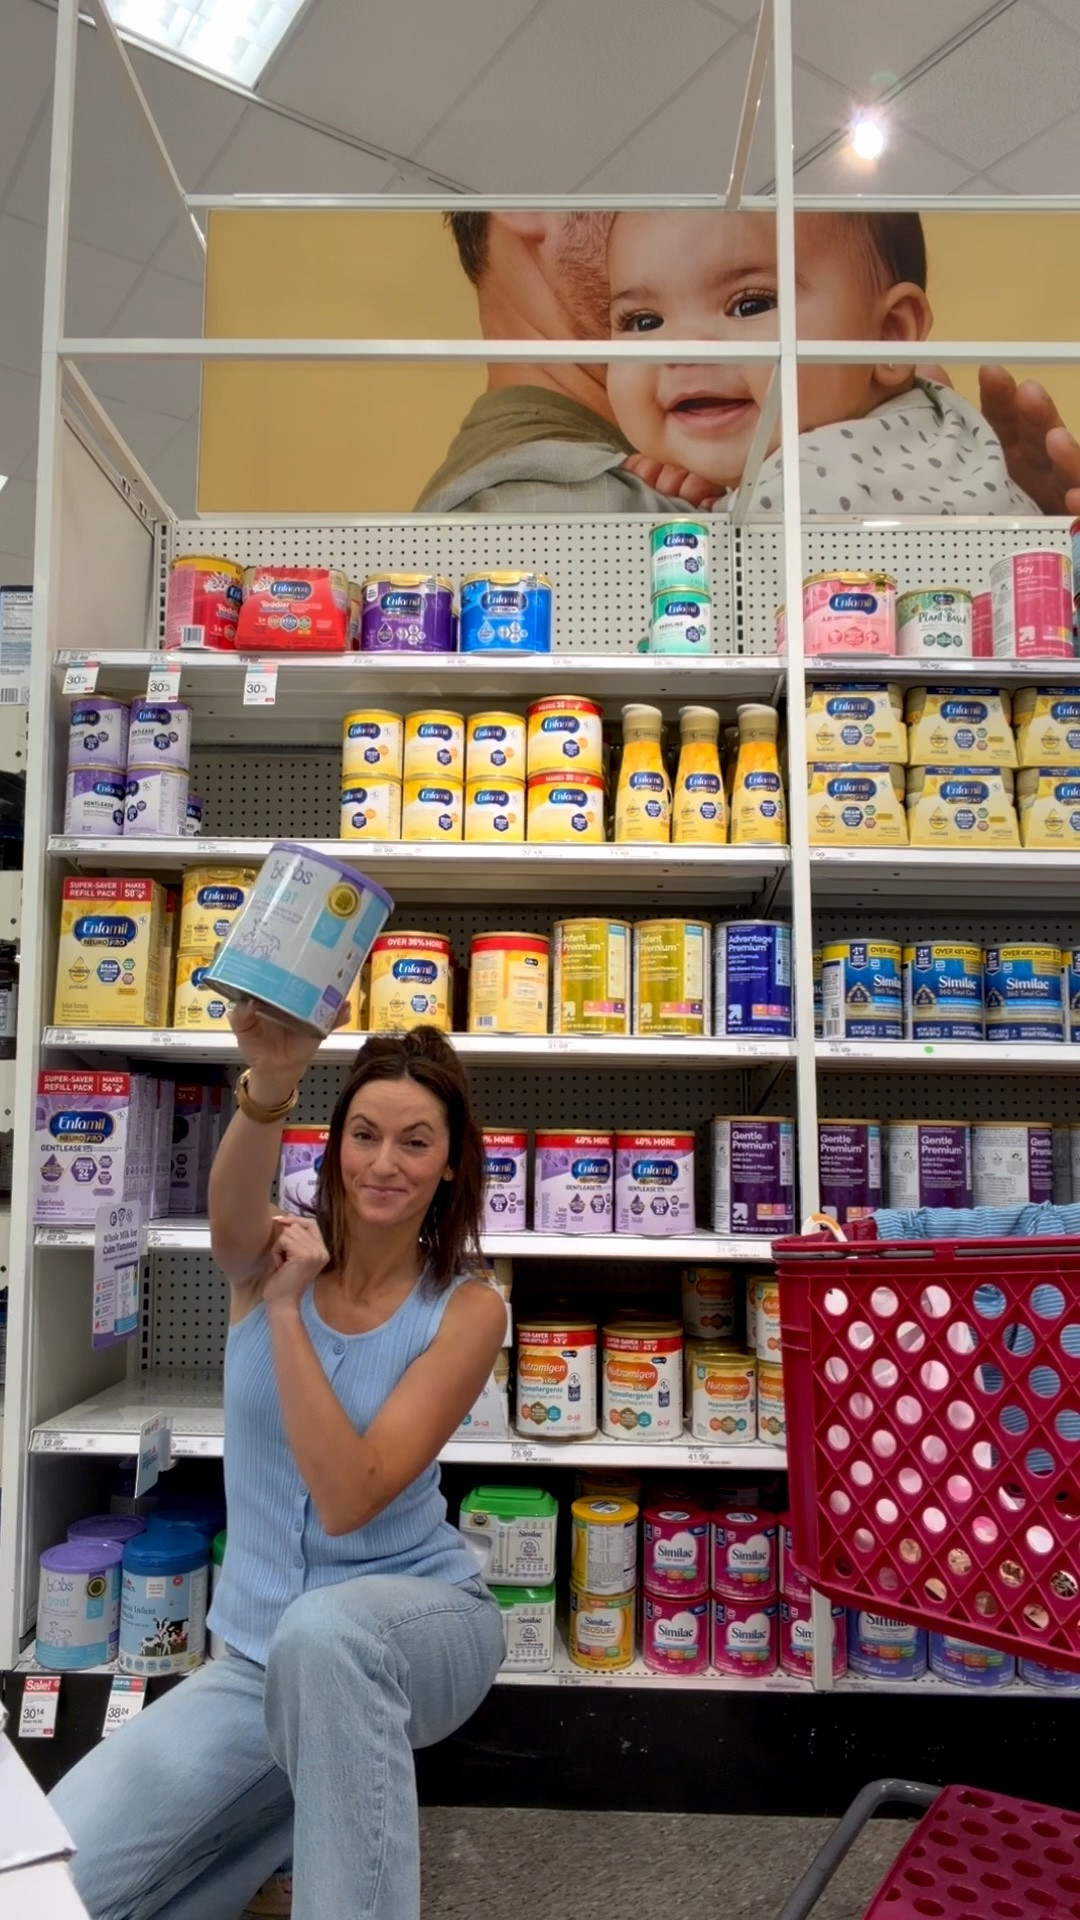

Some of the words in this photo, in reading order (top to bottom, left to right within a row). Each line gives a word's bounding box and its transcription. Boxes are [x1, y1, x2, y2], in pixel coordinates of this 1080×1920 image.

[665, 534, 697, 547] Enfamil
[1017, 565, 1034, 575] Soy
[834, 595, 874, 608] Enfamil
[667, 603, 698, 615] Enfamil
[832, 700, 868, 711] Enfamil
[946, 704, 981, 715] Enfamil
[1056, 705, 1080, 715] Enfa
[543, 718, 575, 729] Enfamil
[350, 726, 377, 736] Enfamil
[420, 725, 449, 736] Enfamil
[475, 728, 504, 738] Enfamil
[633, 776, 661, 784] Enfamil
[689, 778, 717, 786] Enfamil
[748, 776, 777, 784] Enfamil
[833, 780, 870, 793] Enfamil
[946, 783, 983, 795] Enfamil
[421, 791, 450, 801] Enfamil
[477, 793, 506, 803] Enfamil
[552, 791, 585, 802] Enfamil
[70, 889, 95, 897] REFILL
[97, 889, 116, 897] PACK
[202, 890, 239, 902] Enfamil
[82, 922, 129, 934] Enfamil
[387, 938, 407, 946] OVER
[424, 940, 443, 949] MORE
[728, 935, 773, 945] Advantage
[728, 944, 767, 952] Premium
[1002, 950, 1021, 958] OVER
[398, 963, 433, 974] Enfamil
[938, 976, 977, 989] Similac
[1006, 977, 1049, 990] Similac
[44, 1075, 94, 1083] SUPER-SAVER
[44, 1084, 71, 1092] REFILL
[73, 1084, 93, 1092] PACK
[102, 1084, 112, 1092] 56
[58, 1116, 106, 1130] Enfamil
[493, 1136, 514, 1144] MORE
[732, 1131, 763, 1140] Gentle
[820, 1134, 851, 1144] Gentle
[921, 1135, 953, 1145] Gentle
[653, 1138, 676, 1146] MORE
[732, 1141, 772, 1150] Premium
[821, 1144, 862, 1154] Premium
[921, 1145, 962, 1155] Premium
[483, 1162, 512, 1172] nfamil
[637, 1164, 673, 1176] Enfamil
[78, 1169, 89, 1177] 24
[120, 1231, 129, 1239] Milk
[103, 1244, 115, 1255] Calm
[116, 1240, 137, 1253] Tummies
[511, 1450, 532, 1458] 75.99
[518, 1530, 542, 1538] Similac
[658, 1546, 693, 1558] Similac
[731, 1549, 767, 1560] Similac
[518, 1616, 542, 1625] Similac
[585, 1617, 612, 1627] Similac
[658, 1625, 694, 1638] Similac
[731, 1627, 767, 1639] Similac
[26, 1680, 52, 1691] Sale!
